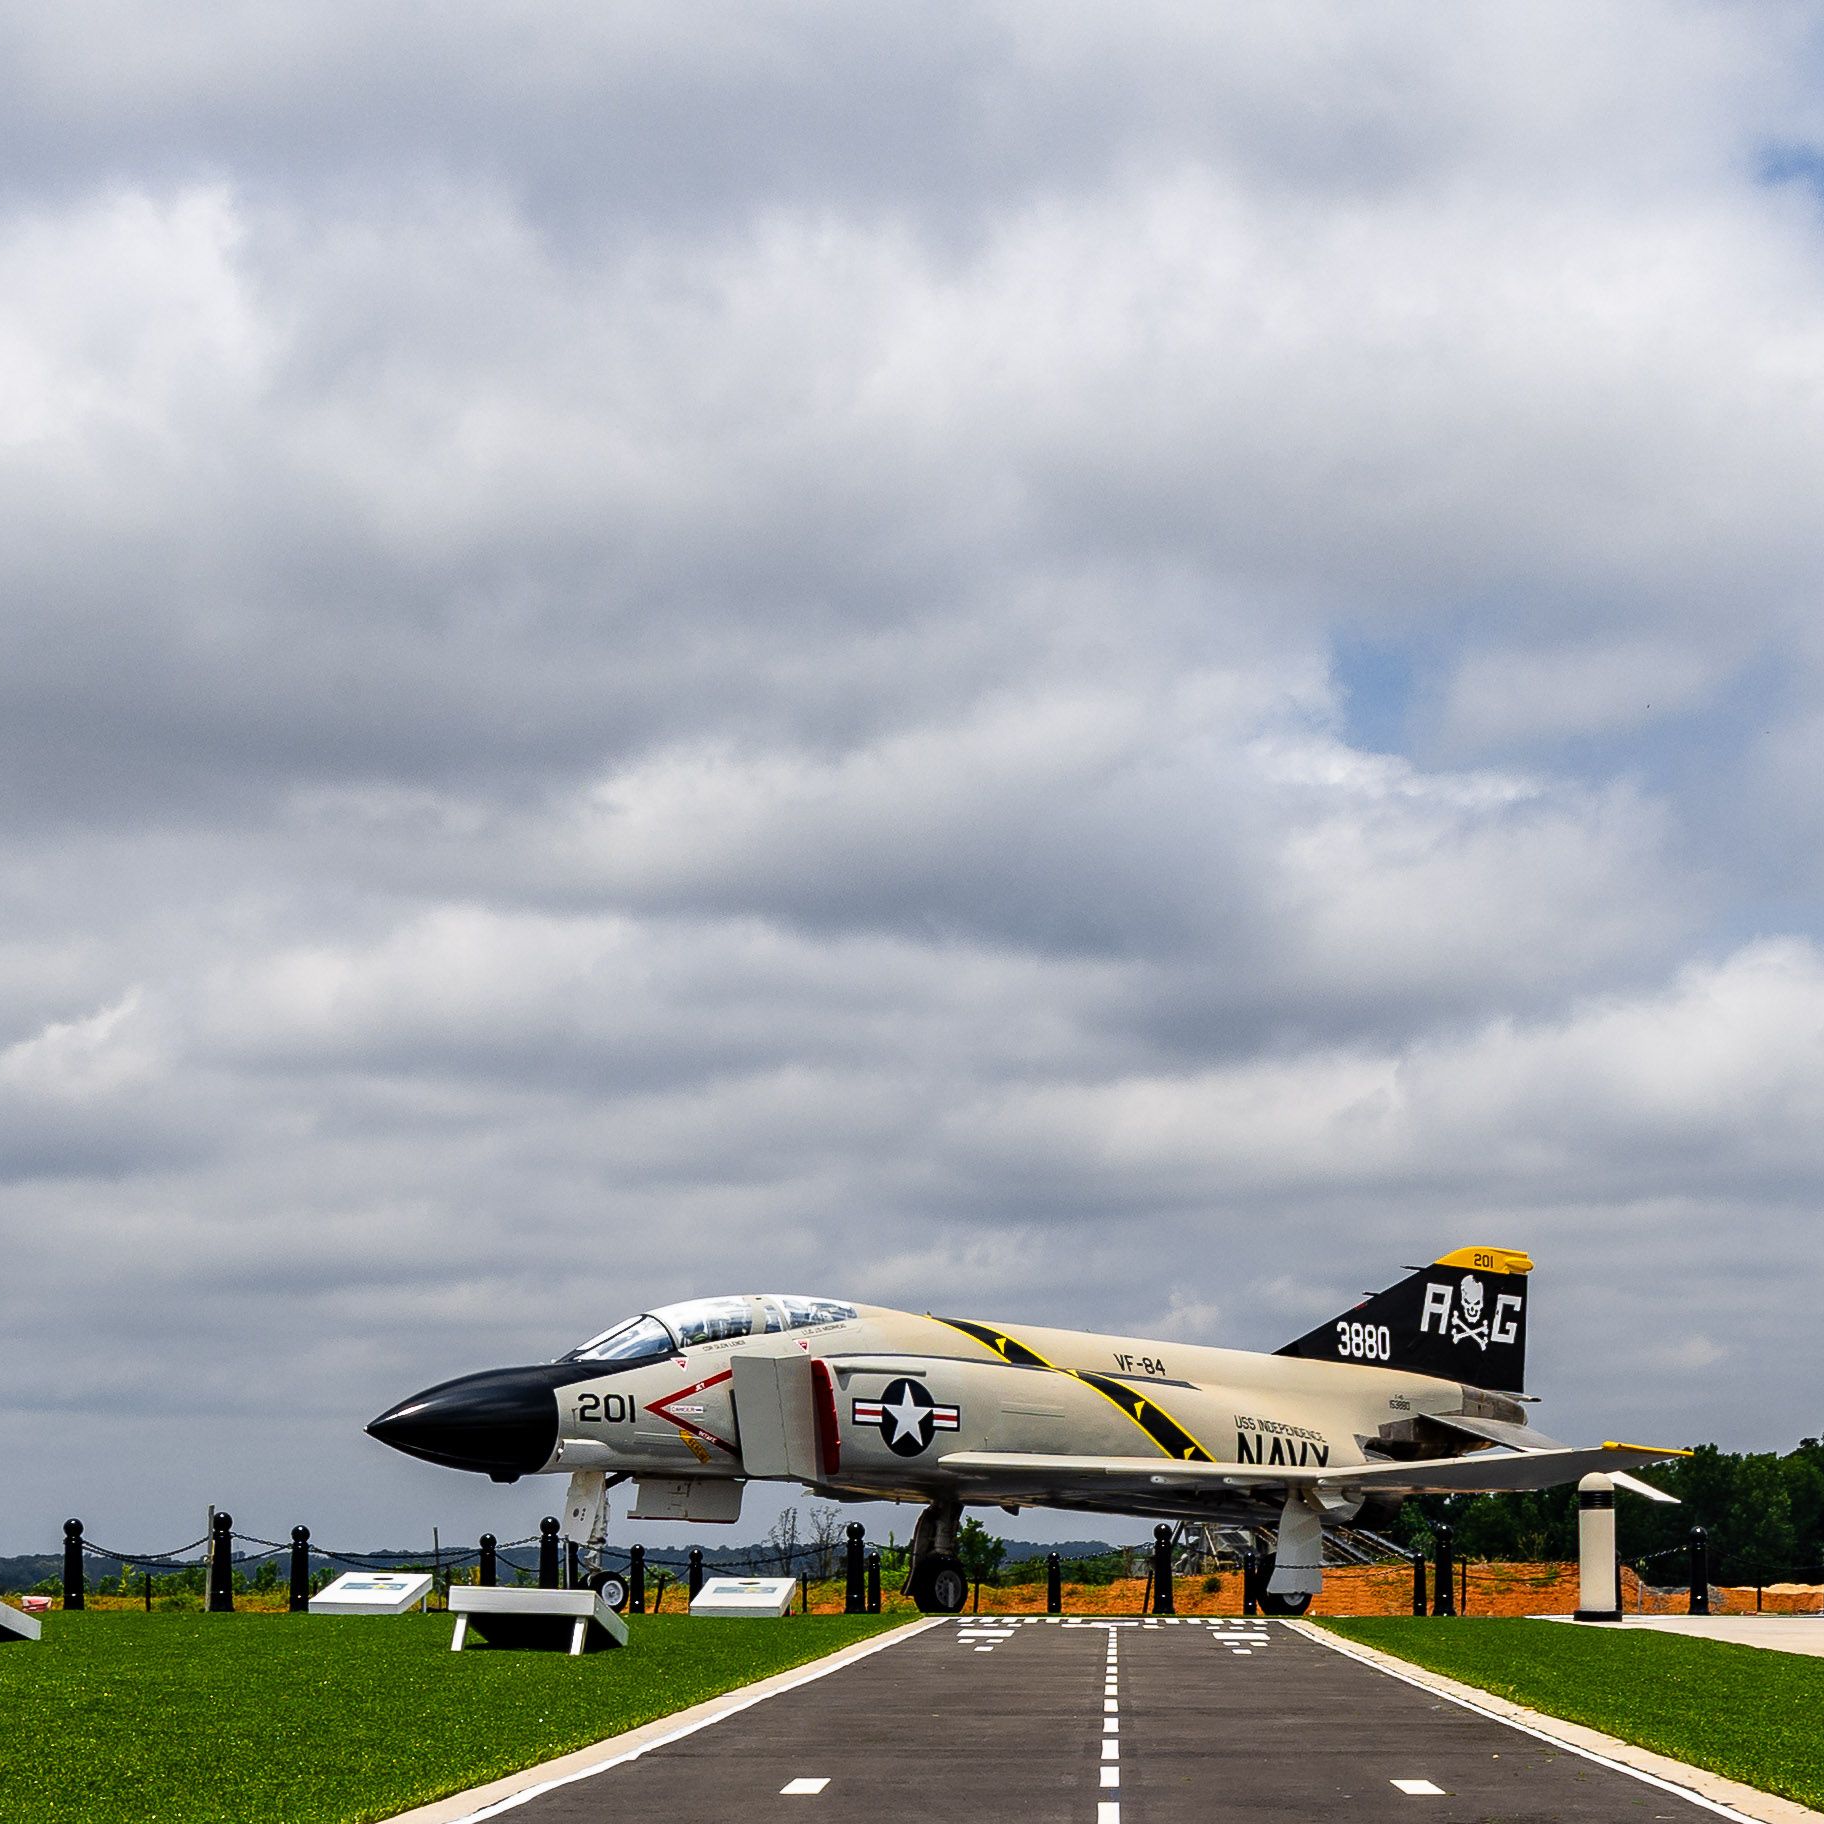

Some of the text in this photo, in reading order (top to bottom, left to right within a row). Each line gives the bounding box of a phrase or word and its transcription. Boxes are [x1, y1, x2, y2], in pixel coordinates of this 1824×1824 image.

[1473, 1253, 1494, 1269] 201
[1420, 1282, 1522, 1344] A G
[1336, 1321, 1391, 1361] 3880
[1112, 1352, 1166, 1376] VF-84
[577, 1393, 637, 1424] 201
[1234, 1414, 1328, 1443] USS INDEPENDENCE
[1237, 1431, 1330, 1468] NAVY
